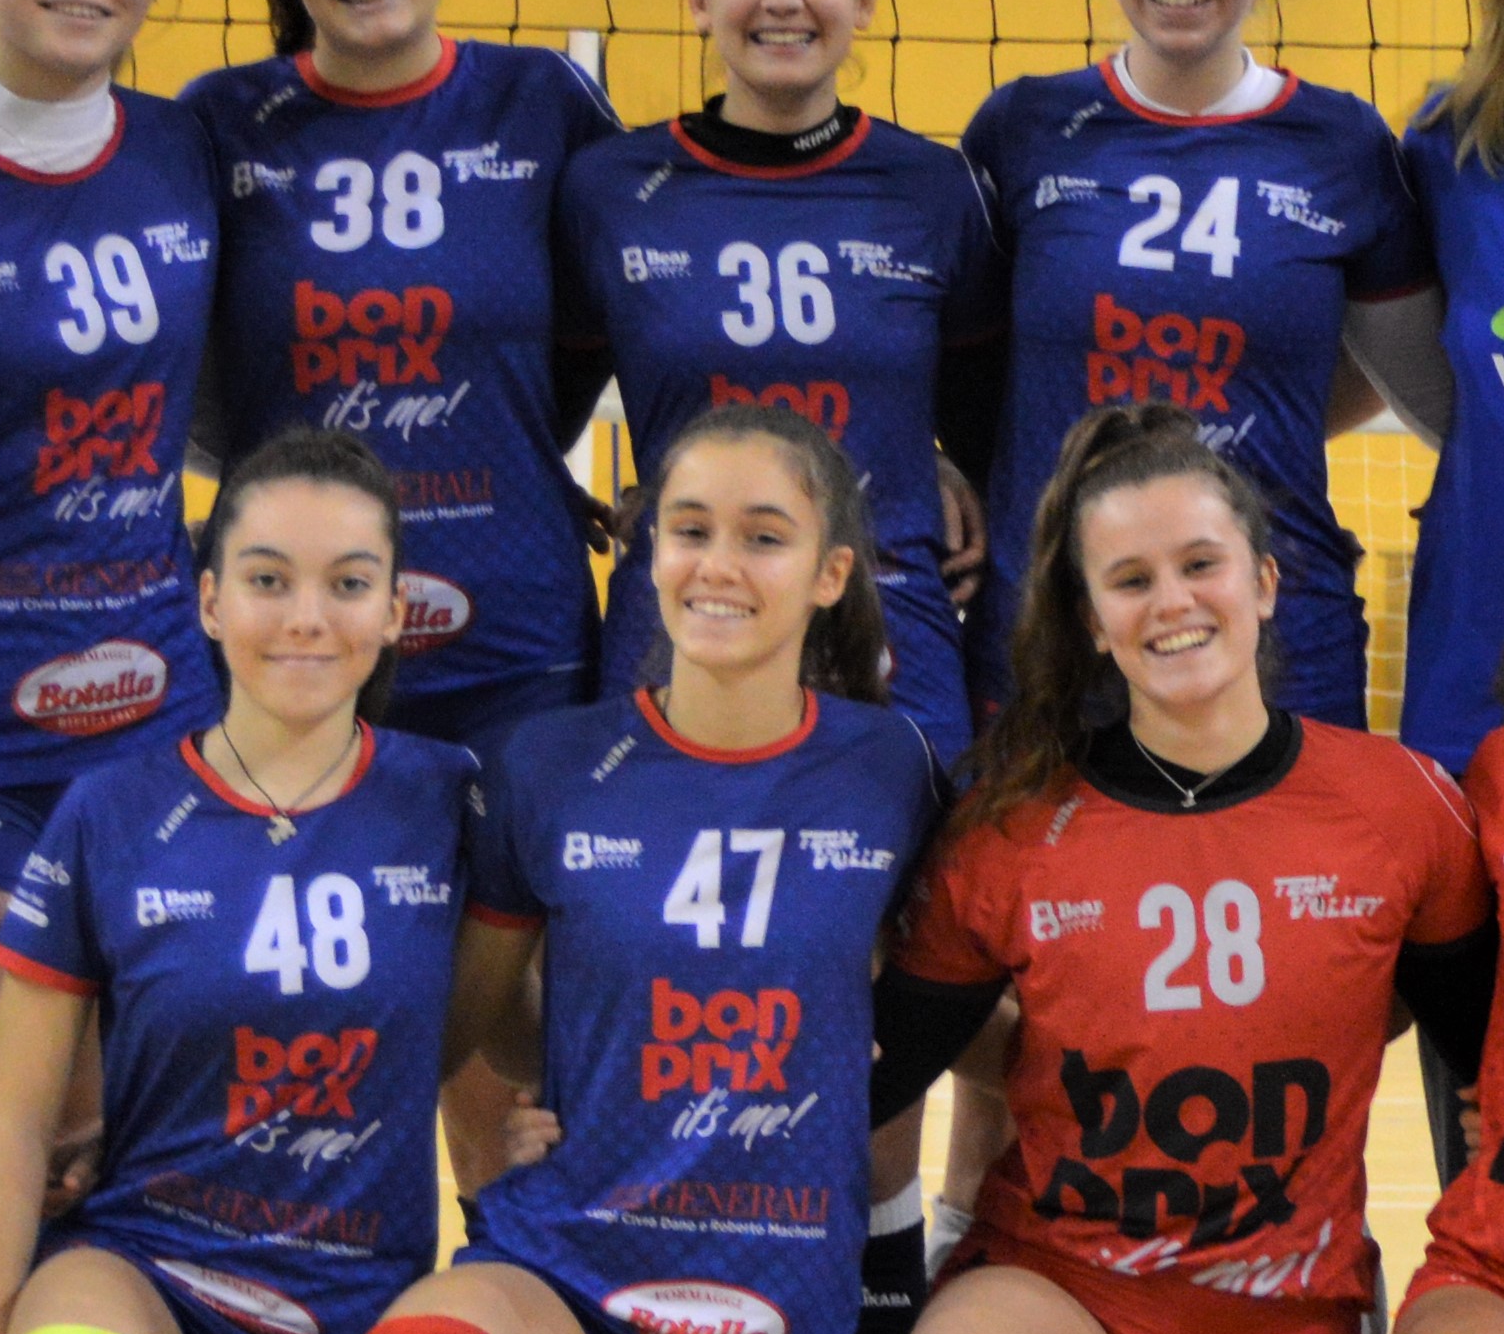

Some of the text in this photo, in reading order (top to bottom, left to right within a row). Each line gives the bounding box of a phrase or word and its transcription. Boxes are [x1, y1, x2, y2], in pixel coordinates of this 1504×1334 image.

[310, 151, 446, 253] 38
[1118, 174, 1241, 278] 24
[44, 234, 160, 354] 39
[295, 280, 453, 339] bon
[718, 241, 836, 347] 36
[1094, 293, 1246, 369] bon
[292, 334, 443, 394] prix
[1086, 352, 1234, 413] prix
[45, 383, 165, 444] bon
[34, 435, 160, 495] prix
[35, 670, 155, 714] Botalla
[664, 829, 785, 947] 47
[244, 873, 371, 995] 48
[1138, 880, 1265, 1011] 28
[651, 978, 801, 1042] bon
[235, 1027, 379, 1082] bon
[642, 1041, 792, 1101] prix
[671, 1086, 819, 1151] it's me!
[1060, 1047, 1330, 1164] bon
[860, 1284, 912, 1308] IKASA
